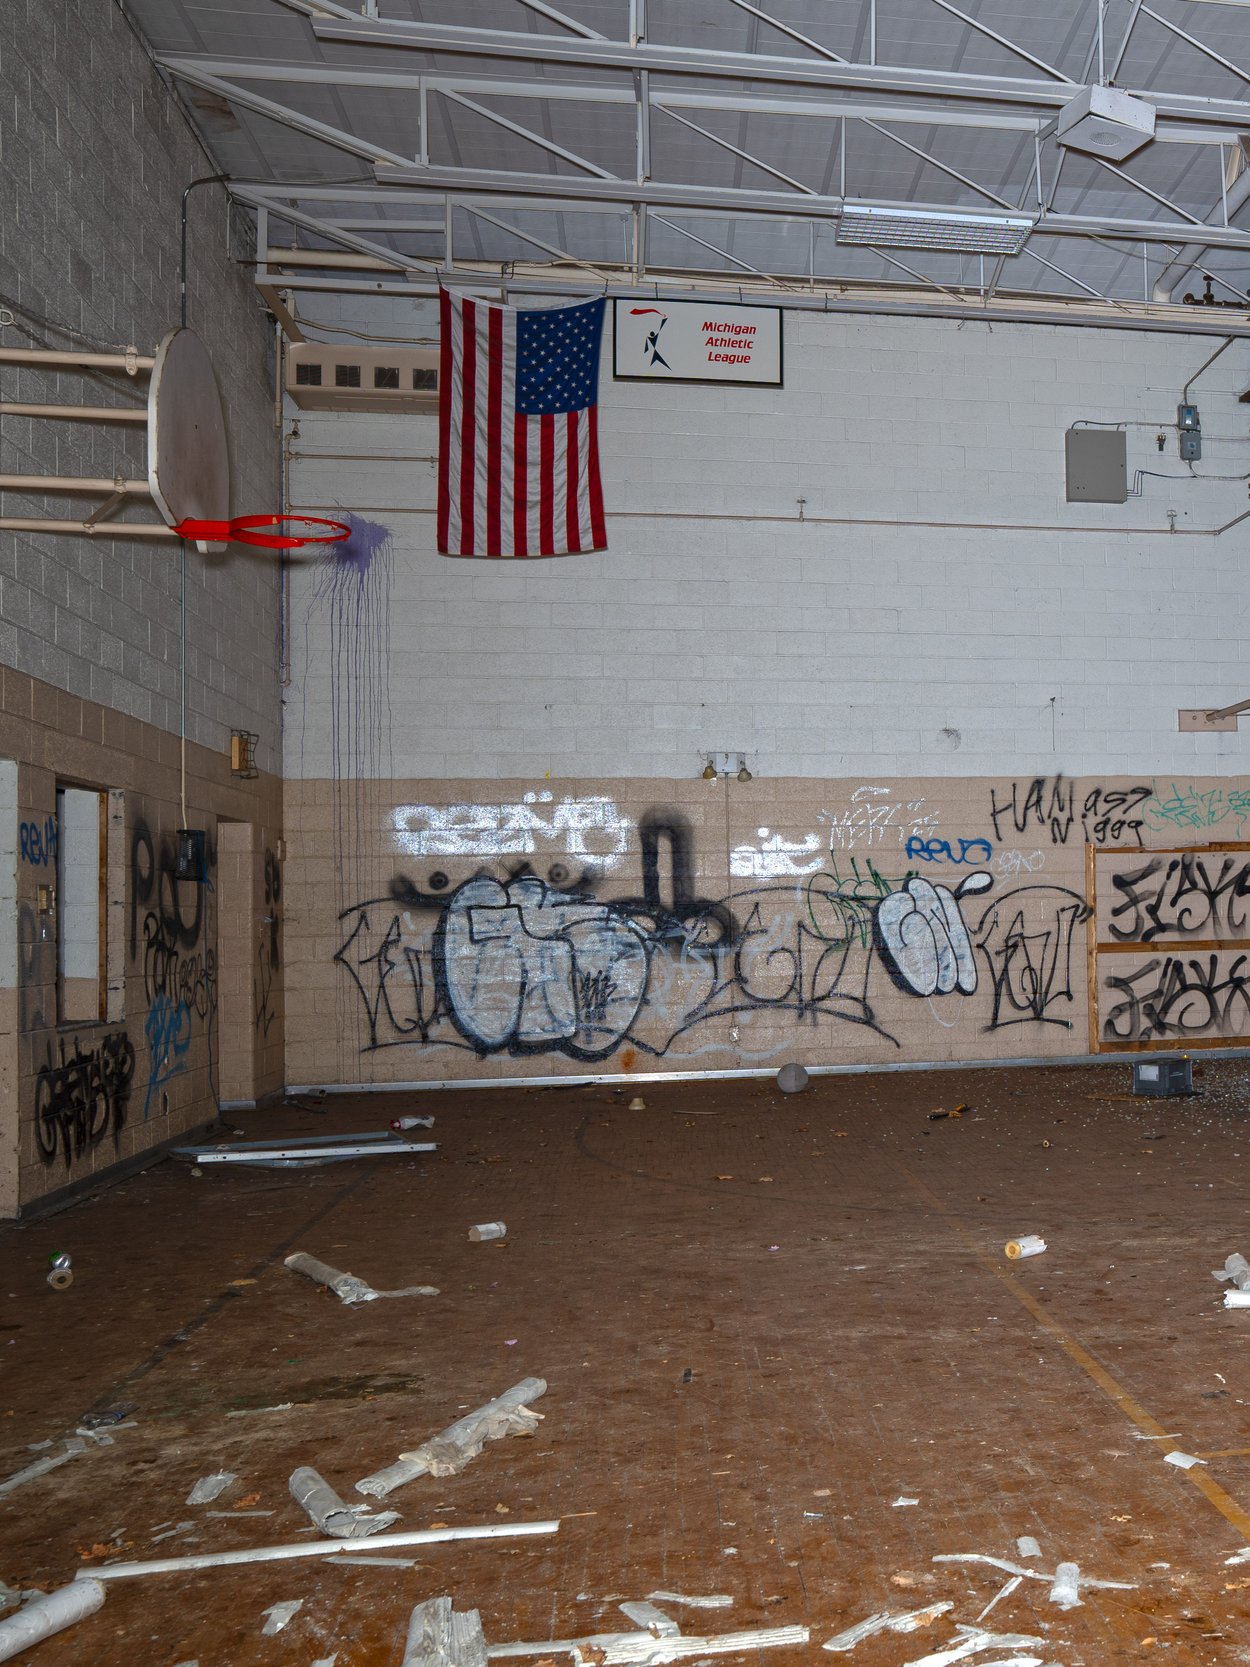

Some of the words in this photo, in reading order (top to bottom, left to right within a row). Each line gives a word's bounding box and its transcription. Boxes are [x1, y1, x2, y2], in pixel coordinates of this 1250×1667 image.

[702, 321, 757, 335] Michigan
[705, 336, 754, 349] Athletic
[708, 351, 751, 364] League
